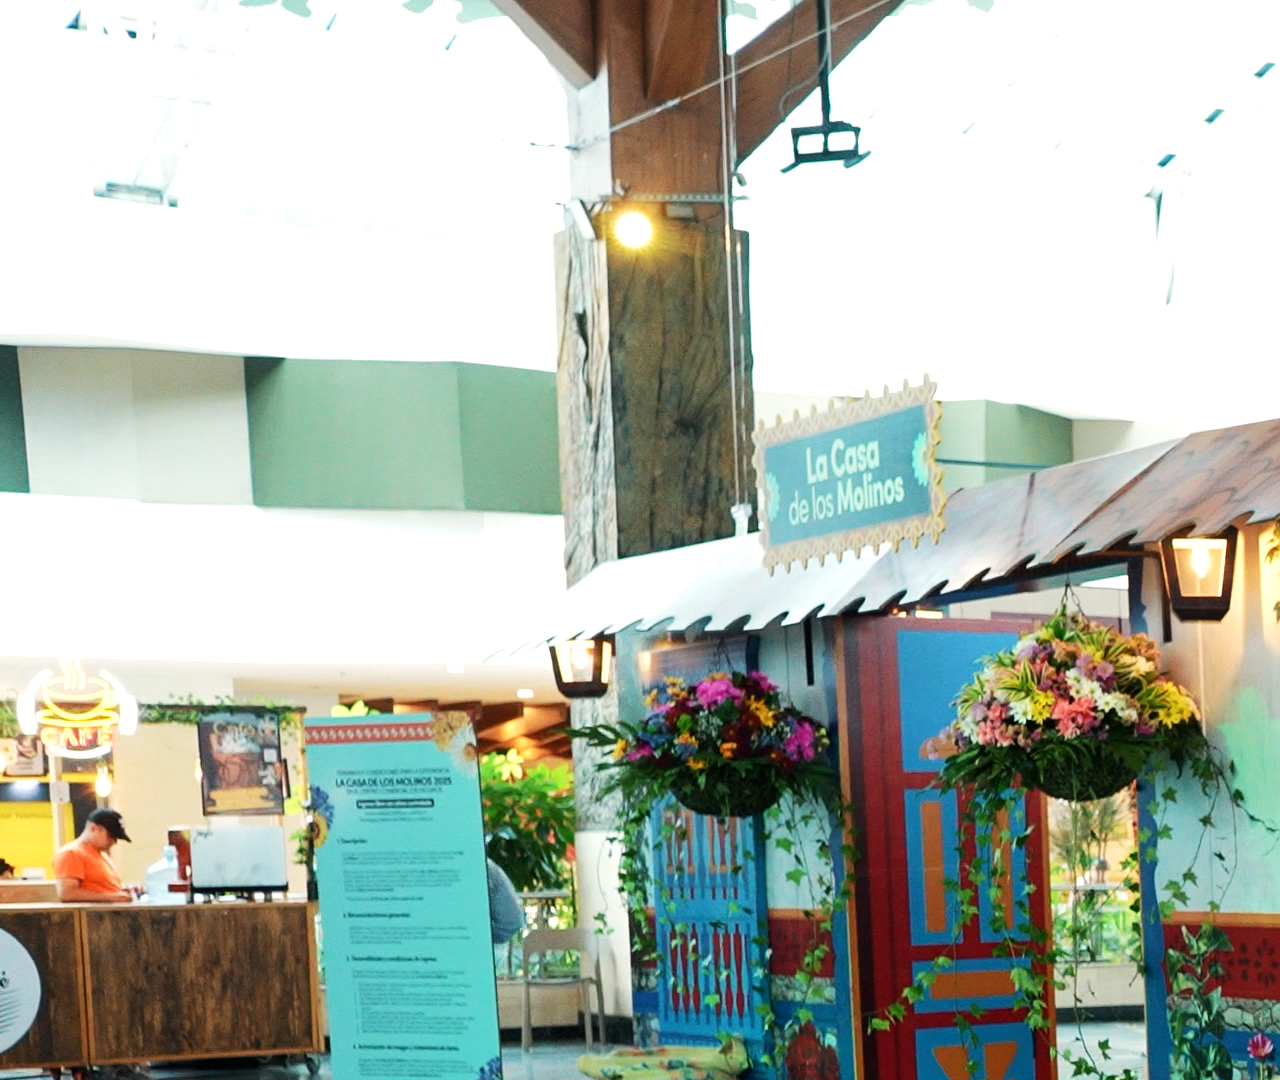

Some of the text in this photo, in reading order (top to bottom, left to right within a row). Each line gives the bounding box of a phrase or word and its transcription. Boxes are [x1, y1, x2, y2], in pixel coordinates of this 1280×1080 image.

[806, 438, 880, 485] La Casa
[788, 472, 905, 527] de los Molinos
[346, 777, 367, 788] CASA
[379, 777, 394, 787] LOS
[396, 776, 432, 787] MOLINOS
